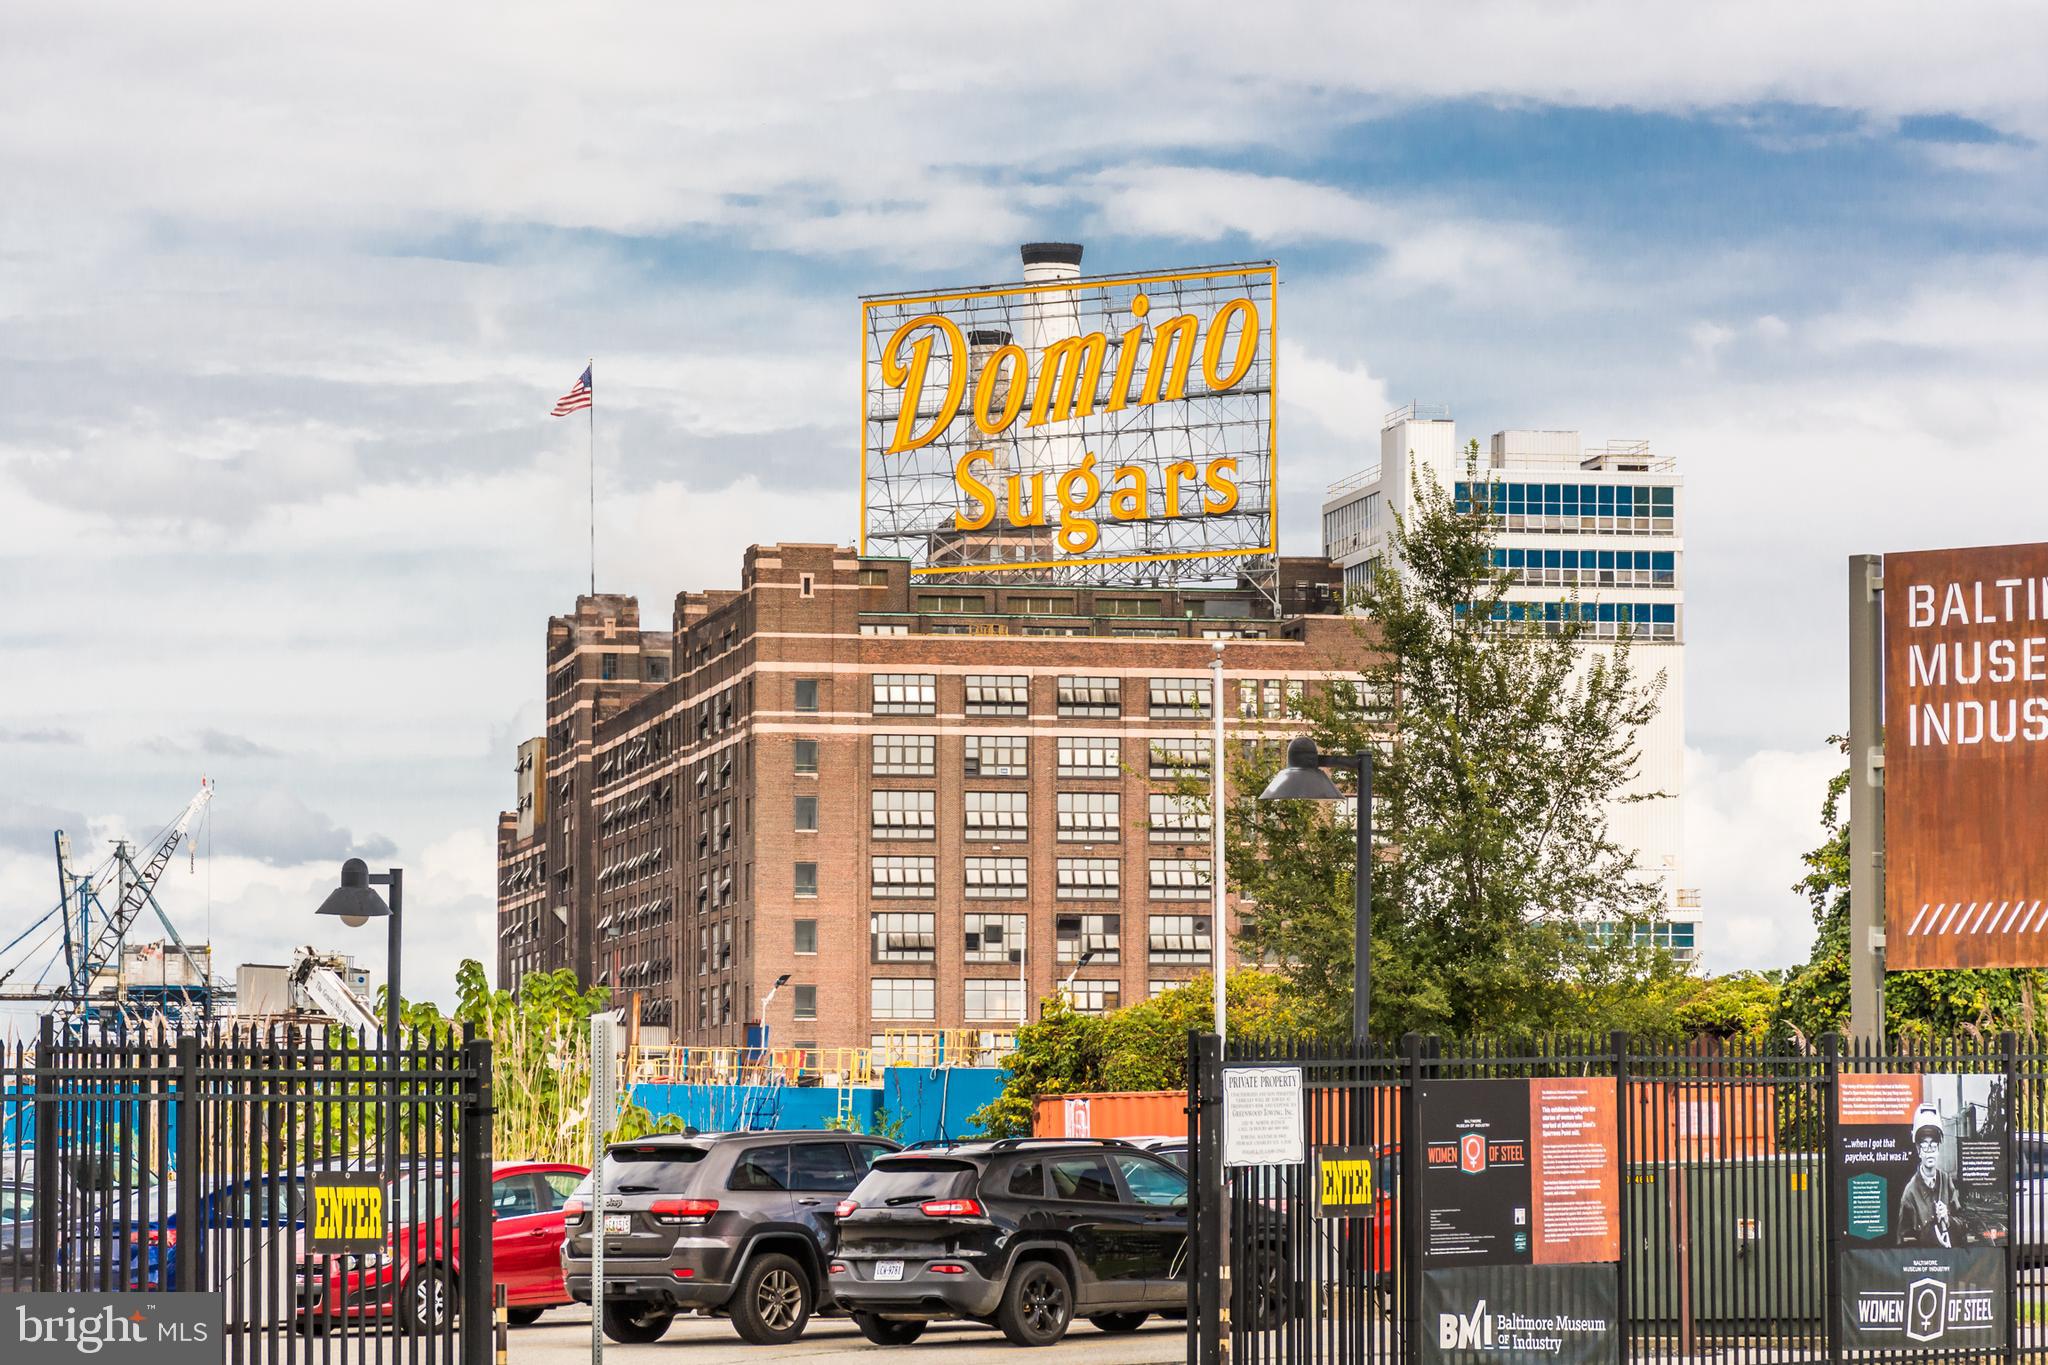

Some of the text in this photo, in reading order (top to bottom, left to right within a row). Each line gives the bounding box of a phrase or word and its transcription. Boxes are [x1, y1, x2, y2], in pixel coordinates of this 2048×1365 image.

[882, 293, 1260, 455] Domino
[955, 451, 1240, 553] Sugars
[1908, 577, 2048, 628] BALTI
[1909, 697, 2048, 747] INDUS
[1229, 1075, 1297, 1088] PRIVATE PROPERTY
[1428, 1146, 1458, 1164] WOMEN
[1488, 1145, 1500, 1162] OF
[1500, 1145, 1525, 1161] STEEL
[1844, 1151, 1875, 1164] paycheck,
[1876, 1151, 1889, 1161] that
[1889, 1153, 1901, 1161] was
[1871, 1138, 1882, 1150] got
[1883, 1138, 1895, 1148] that
[1321, 1159, 1372, 1206] ENTER
[314, 1186, 383, 1240] ENTER
[1440, 1299, 1606, 1350] BMI Baltimore Museum
[1858, 1298, 1994, 1323] WOMEN OF STEEL
[1498, 1332, 1562, 1354] OF Industry
